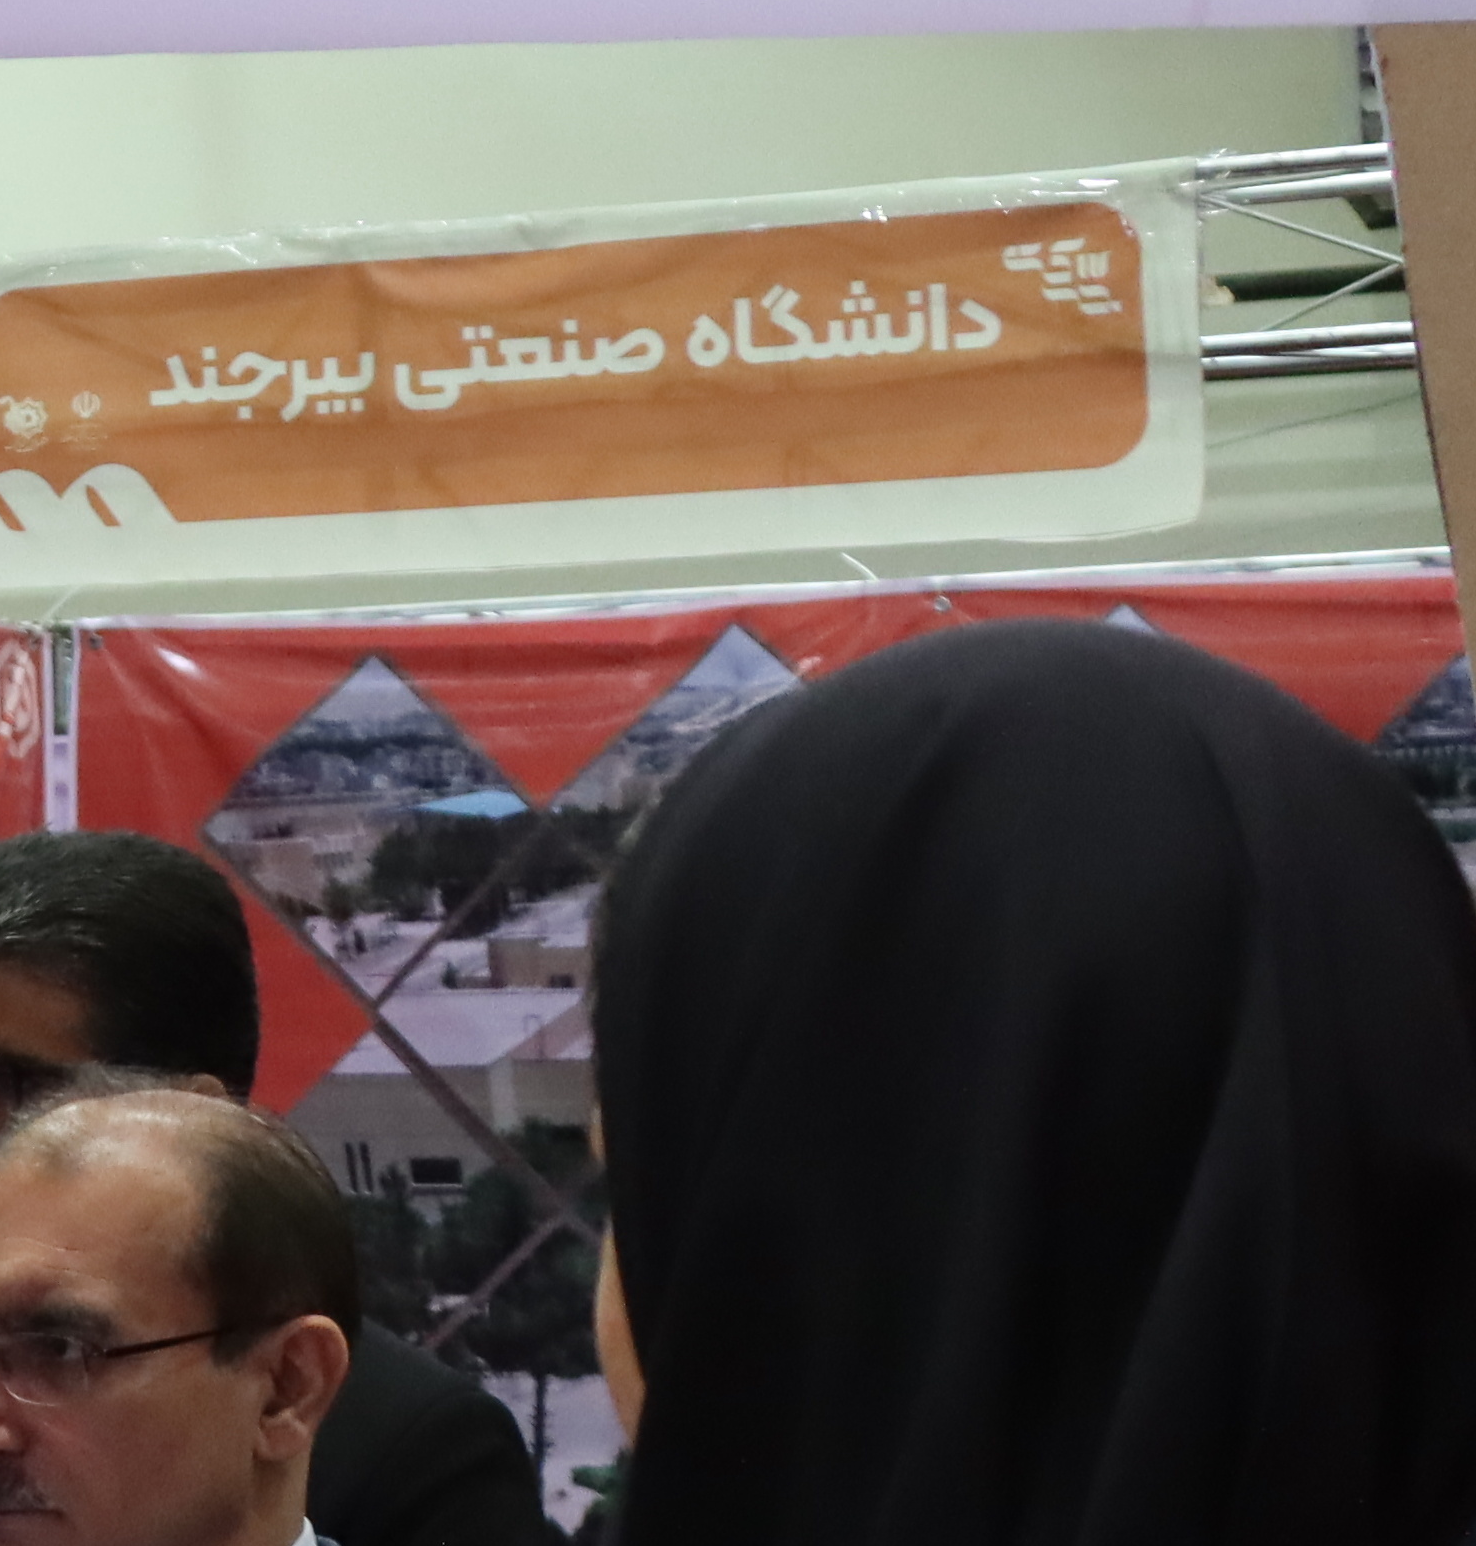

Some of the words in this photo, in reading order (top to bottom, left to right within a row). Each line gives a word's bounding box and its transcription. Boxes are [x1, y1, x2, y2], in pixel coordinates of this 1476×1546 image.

[393, 318, 666, 410] صنعتی
[687, 280, 1002, 368] دانشگاه
[148, 345, 376, 422] بیرجند
